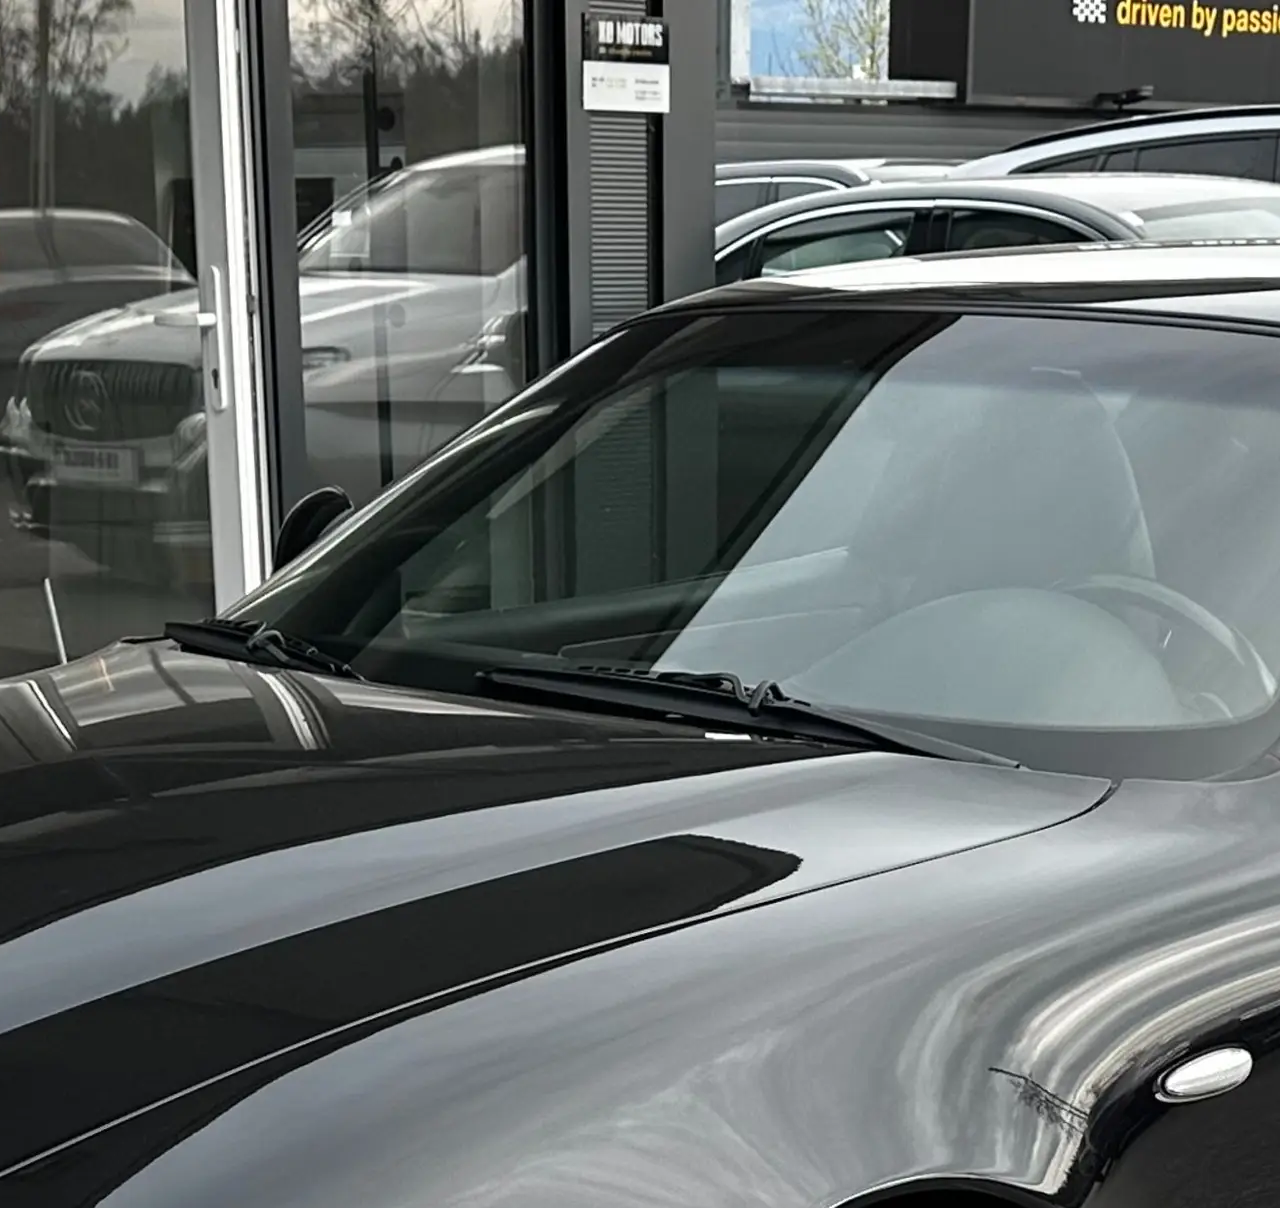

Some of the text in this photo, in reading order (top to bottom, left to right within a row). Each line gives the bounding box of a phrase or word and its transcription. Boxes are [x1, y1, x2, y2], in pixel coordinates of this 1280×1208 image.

[1116, 0, 1185, 28] driven
[1191, 1, 1218, 37] by
[616, 22, 664, 47] MOTORS
